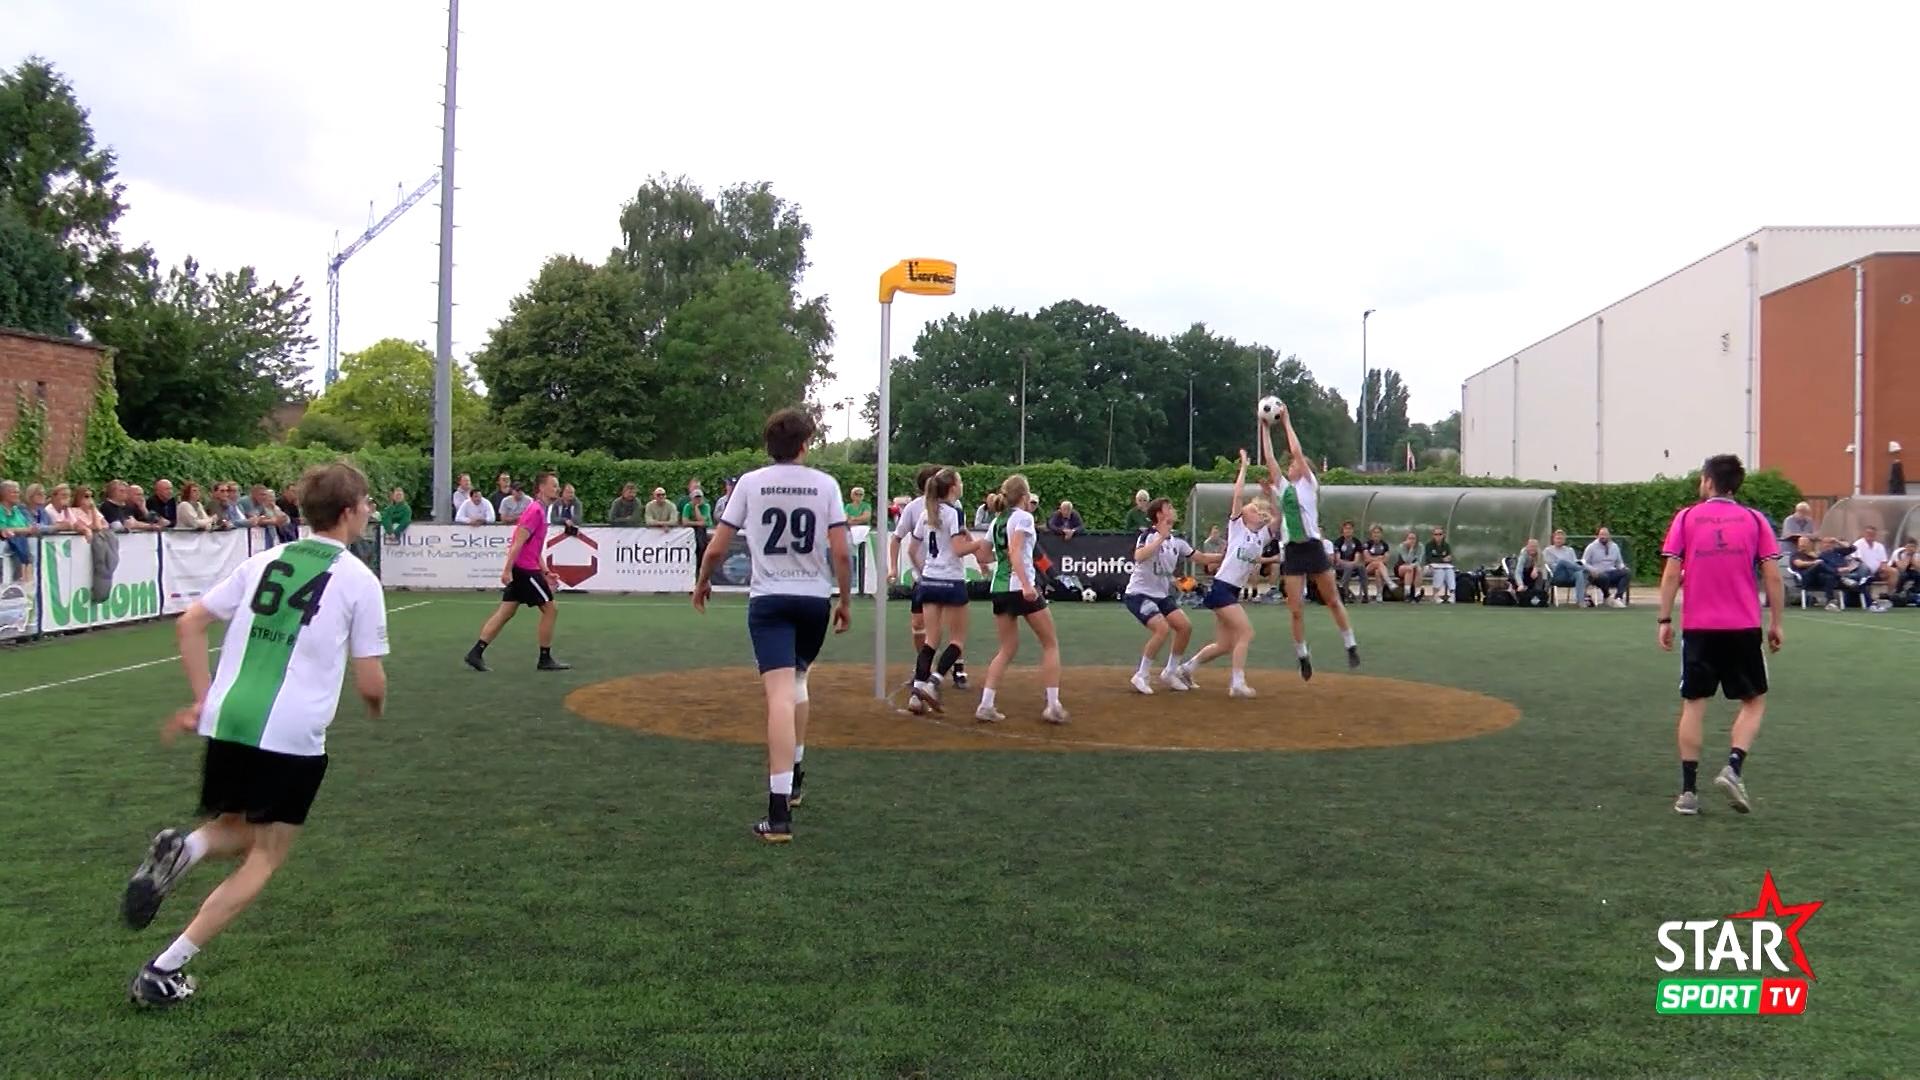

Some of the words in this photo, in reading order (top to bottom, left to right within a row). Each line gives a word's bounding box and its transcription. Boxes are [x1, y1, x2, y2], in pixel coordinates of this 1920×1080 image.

[762, 507, 816, 555] 29
[929, 531, 939, 558] 4
[616, 540, 690, 564] interim
[250, 559, 333, 627] 64
